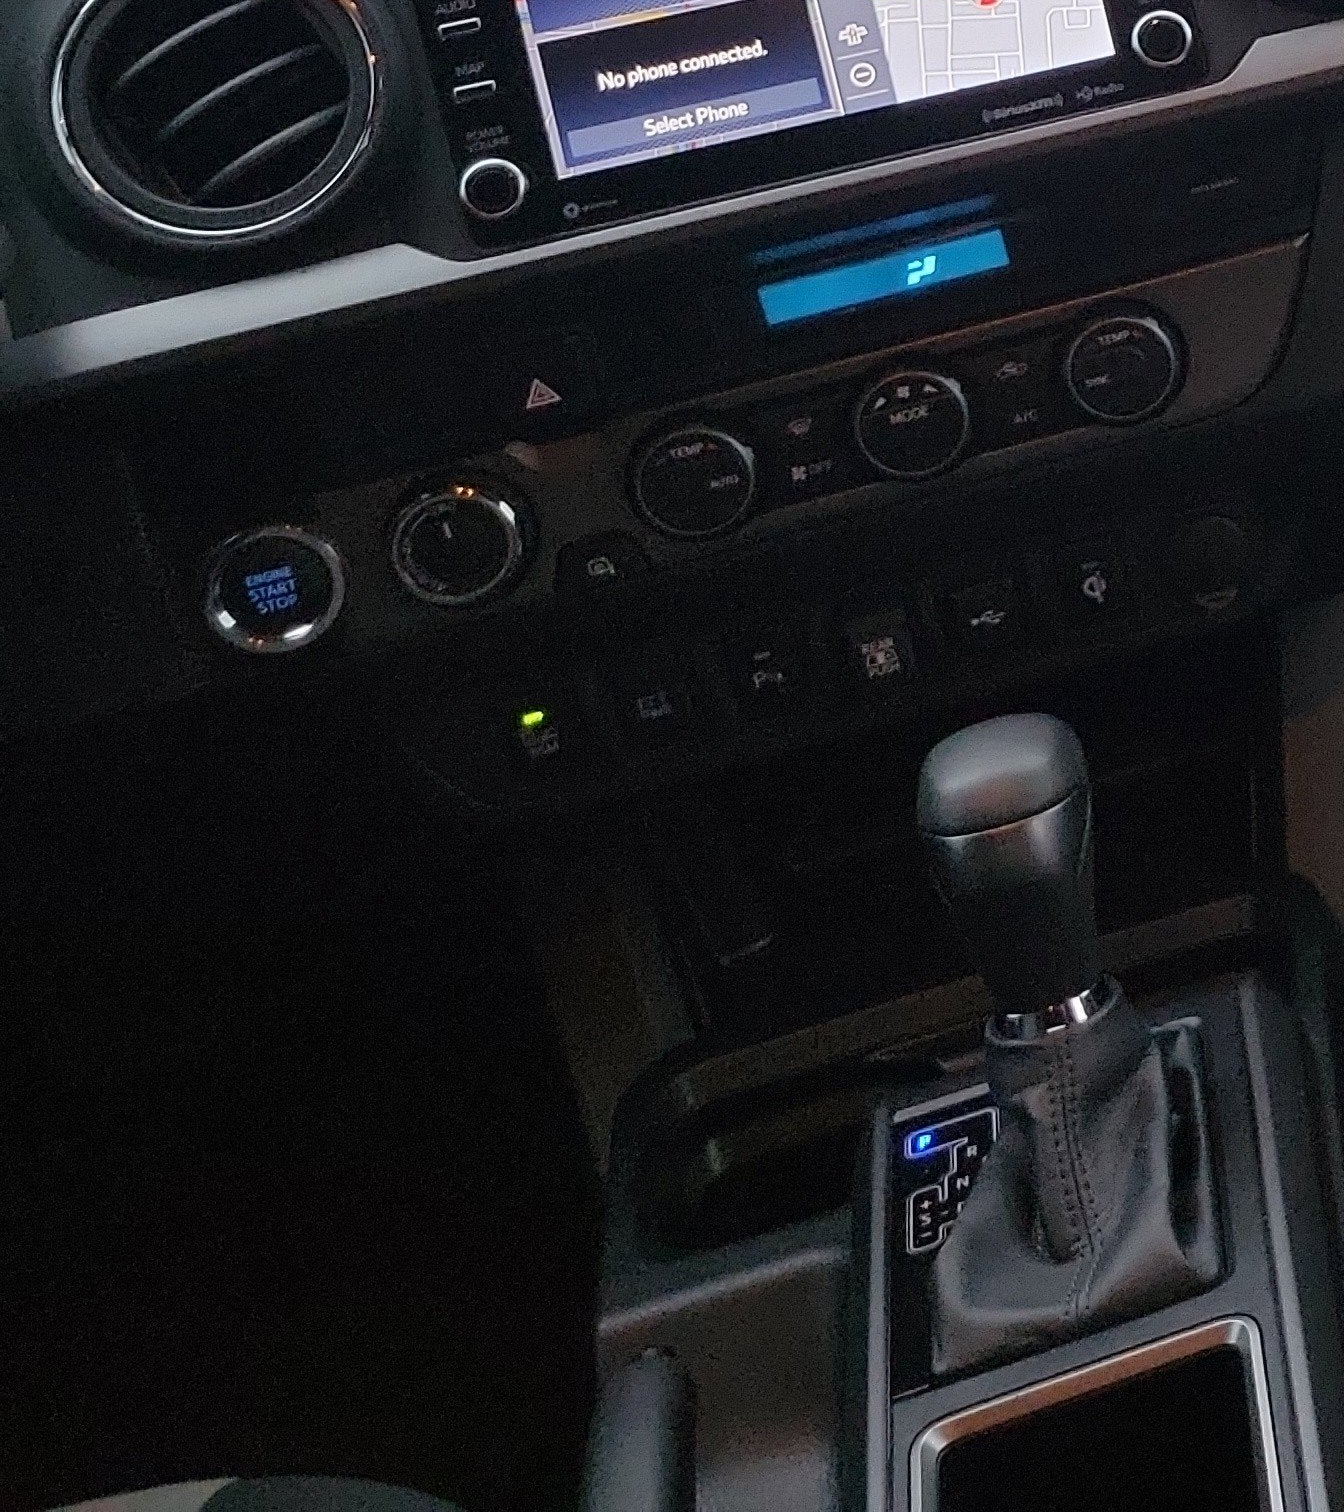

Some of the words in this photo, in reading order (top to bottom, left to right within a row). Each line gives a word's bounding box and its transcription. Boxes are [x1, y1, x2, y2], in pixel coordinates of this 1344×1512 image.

[456, 61, 485, 77] MAP
[598, 71, 636, 91] No
[636, 58, 679, 88] phone
[679, 41, 769, 74] connected.
[644, 117, 694, 139] Select
[698, 105, 750, 129] Phone
[891, 403, 929, 424] MODE
[670, 444, 705, 459] TEMP
[249, 578, 297, 603] START
[256, 594, 299, 615] STOP
[916, 1133, 932, 1151] P
[966, 1144, 978, 1159] R
[956, 1176, 970, 1190] N
[918, 1212, 931, 1227] S
